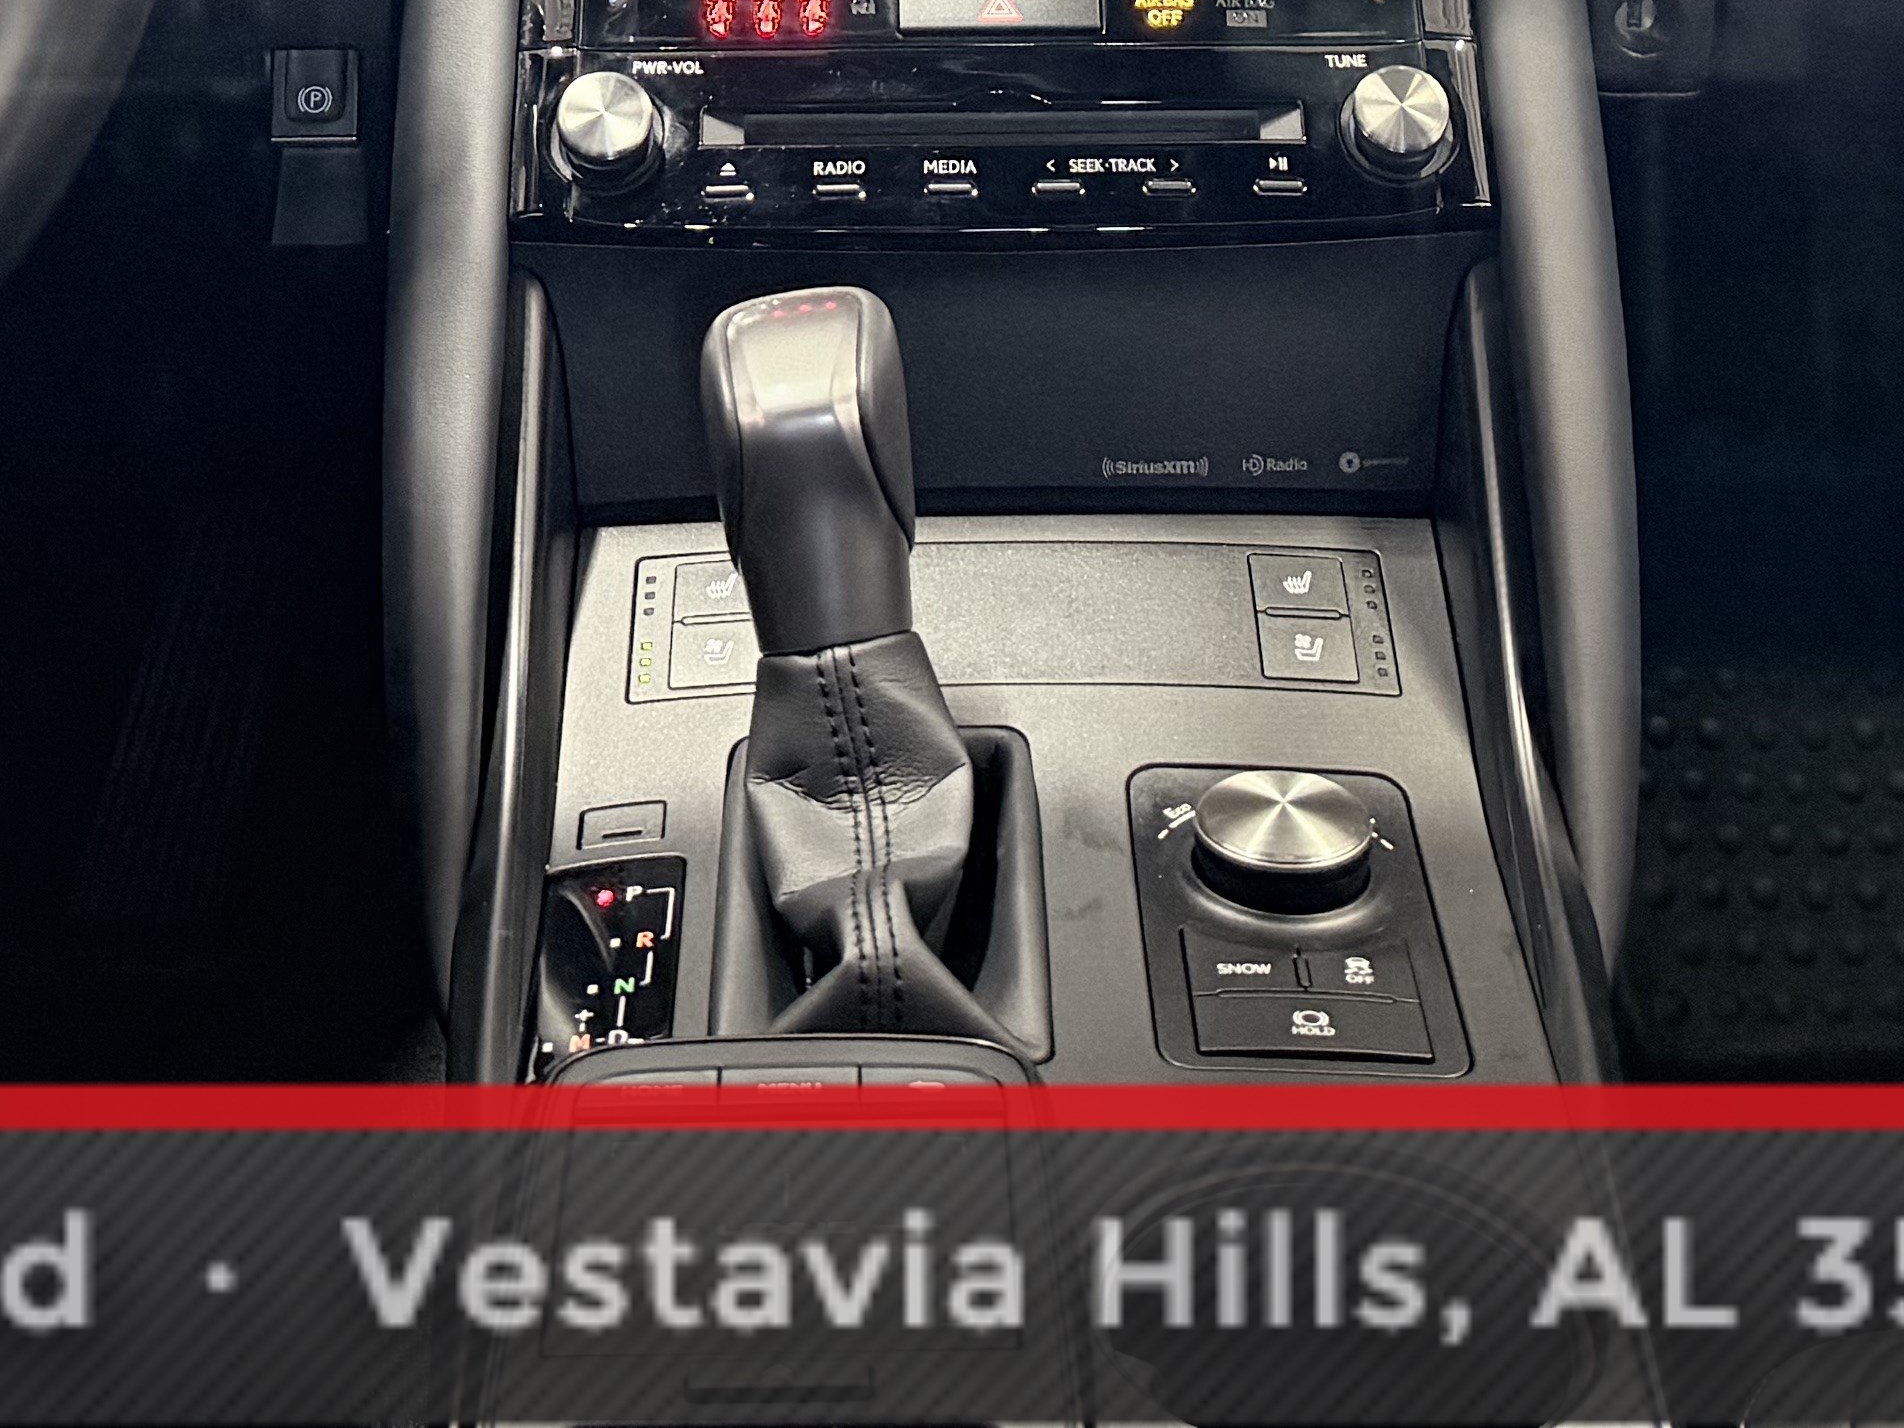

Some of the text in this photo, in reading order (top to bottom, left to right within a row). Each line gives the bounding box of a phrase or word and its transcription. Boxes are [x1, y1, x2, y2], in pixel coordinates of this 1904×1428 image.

[1147, 9, 1183, 27] OFF
[1324, 54, 1368, 70] TUNE
[813, 161, 866, 177] RADIO
[923, 160, 977, 176] MEDIA
[1266, 458, 1308, 471] Radio
[1163, 803, 1192, 820] Eco
[625, 885, 644, 902] P
[636, 931, 655, 948] R
[1216, 962, 1272, 976] SNOW
[614, 977, 636, 995] N
[1292, 1025, 1336, 1037] HOLD
[569, 1033, 592, 1053] M
